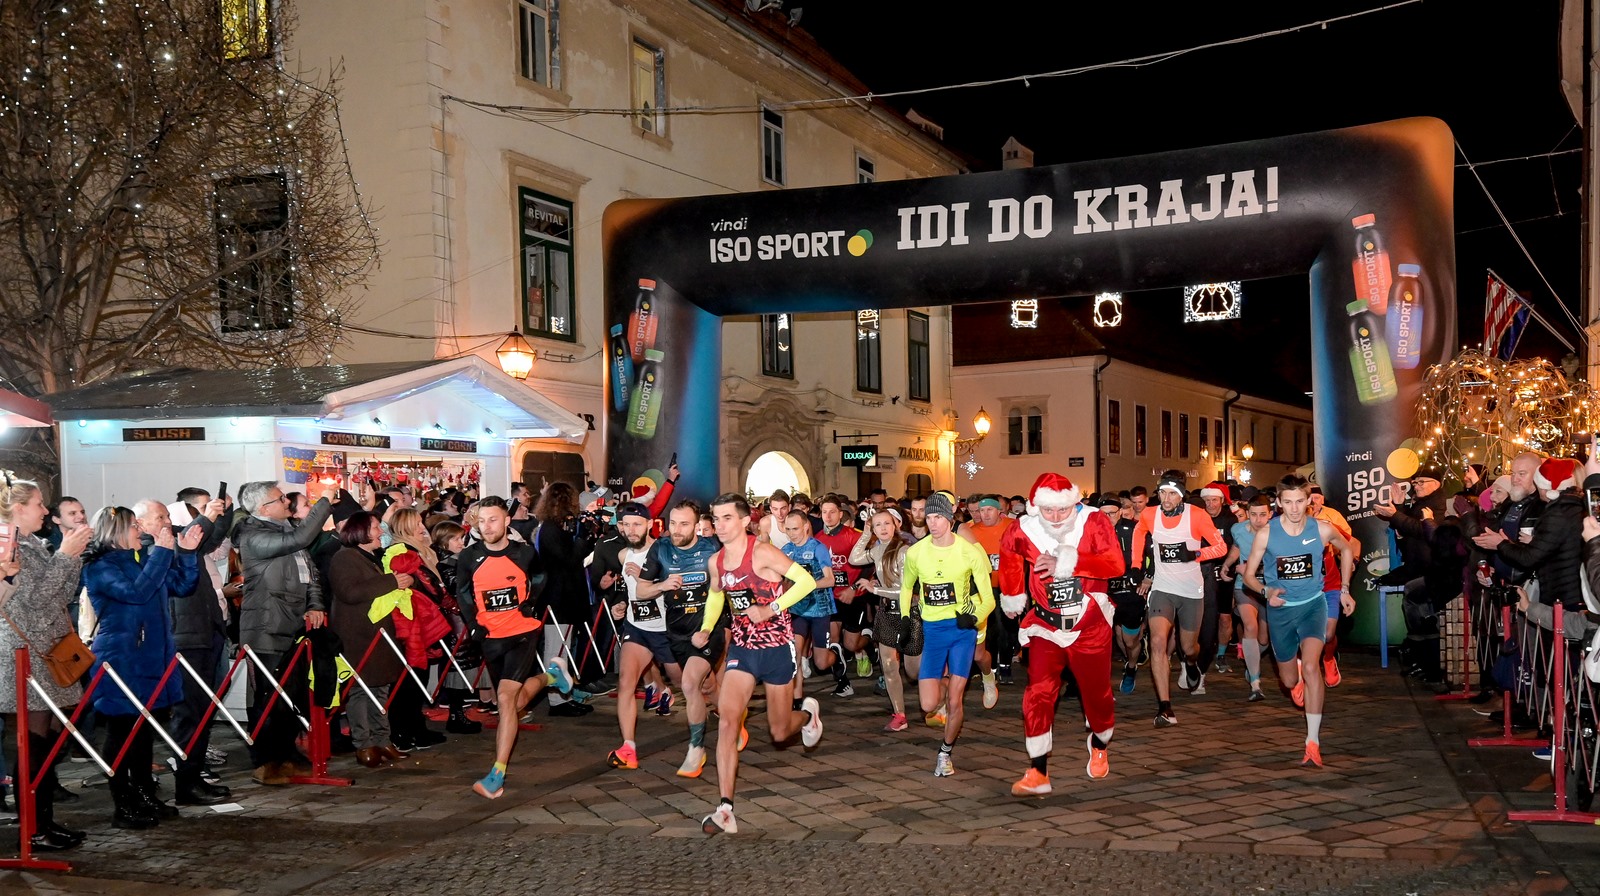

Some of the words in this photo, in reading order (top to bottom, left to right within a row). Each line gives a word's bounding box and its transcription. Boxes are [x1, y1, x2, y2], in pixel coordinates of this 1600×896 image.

[528, 207, 564, 226] REVITAL
[897, 202, 970, 250] IDI
[988, 194, 1053, 243] DO
[1073, 166, 1279, 235] KRAJA!
[710, 217, 749, 232] vindi
[709, 236, 751, 264] ISO
[757, 230, 846, 261] SPORT
[1363, 250, 1378, 286] SPORT
[1369, 287, 1381, 306] ISO
[637, 308, 649, 339] SPORT
[1400, 300, 1412, 338] SPORT
[634, 340, 644, 356] ISO
[1360, 337, 1377, 373] SPORT
[1396, 339, 1408, 358] ISO
[616, 355, 627, 385] SPORT
[1369, 374, 1382, 393] ISO
[620, 385, 629, 402] ISO
[640, 380, 653, 412] SPORT
[636, 410, 646, 430] ISO
[133, 428, 191, 440] SLUSH
[326, 432, 358, 446] COTTON
[360, 435, 386, 447] CANDY
[427, 439, 446, 449] POP
[447, 440, 473, 451] CORN
[843, 451, 873, 460] DOUGLAS
[1345, 450, 1373, 462] vindi
[608, 477, 623, 486] vindi
[1346, 466, 1386, 493] ISO
[612, 490, 631, 508] SO
[1346, 481, 1412, 512] SPOR
[1346, 512, 1363, 521] NOVA
[1284, 561, 1306, 574] 242
[834, 575, 844, 583] 28
[489, 594, 513, 607] 171
[686, 591, 695, 601] 2
[928, 589, 949, 601] 434
[1052, 587, 1075, 602] 257
[637, 605, 650, 617] 29
